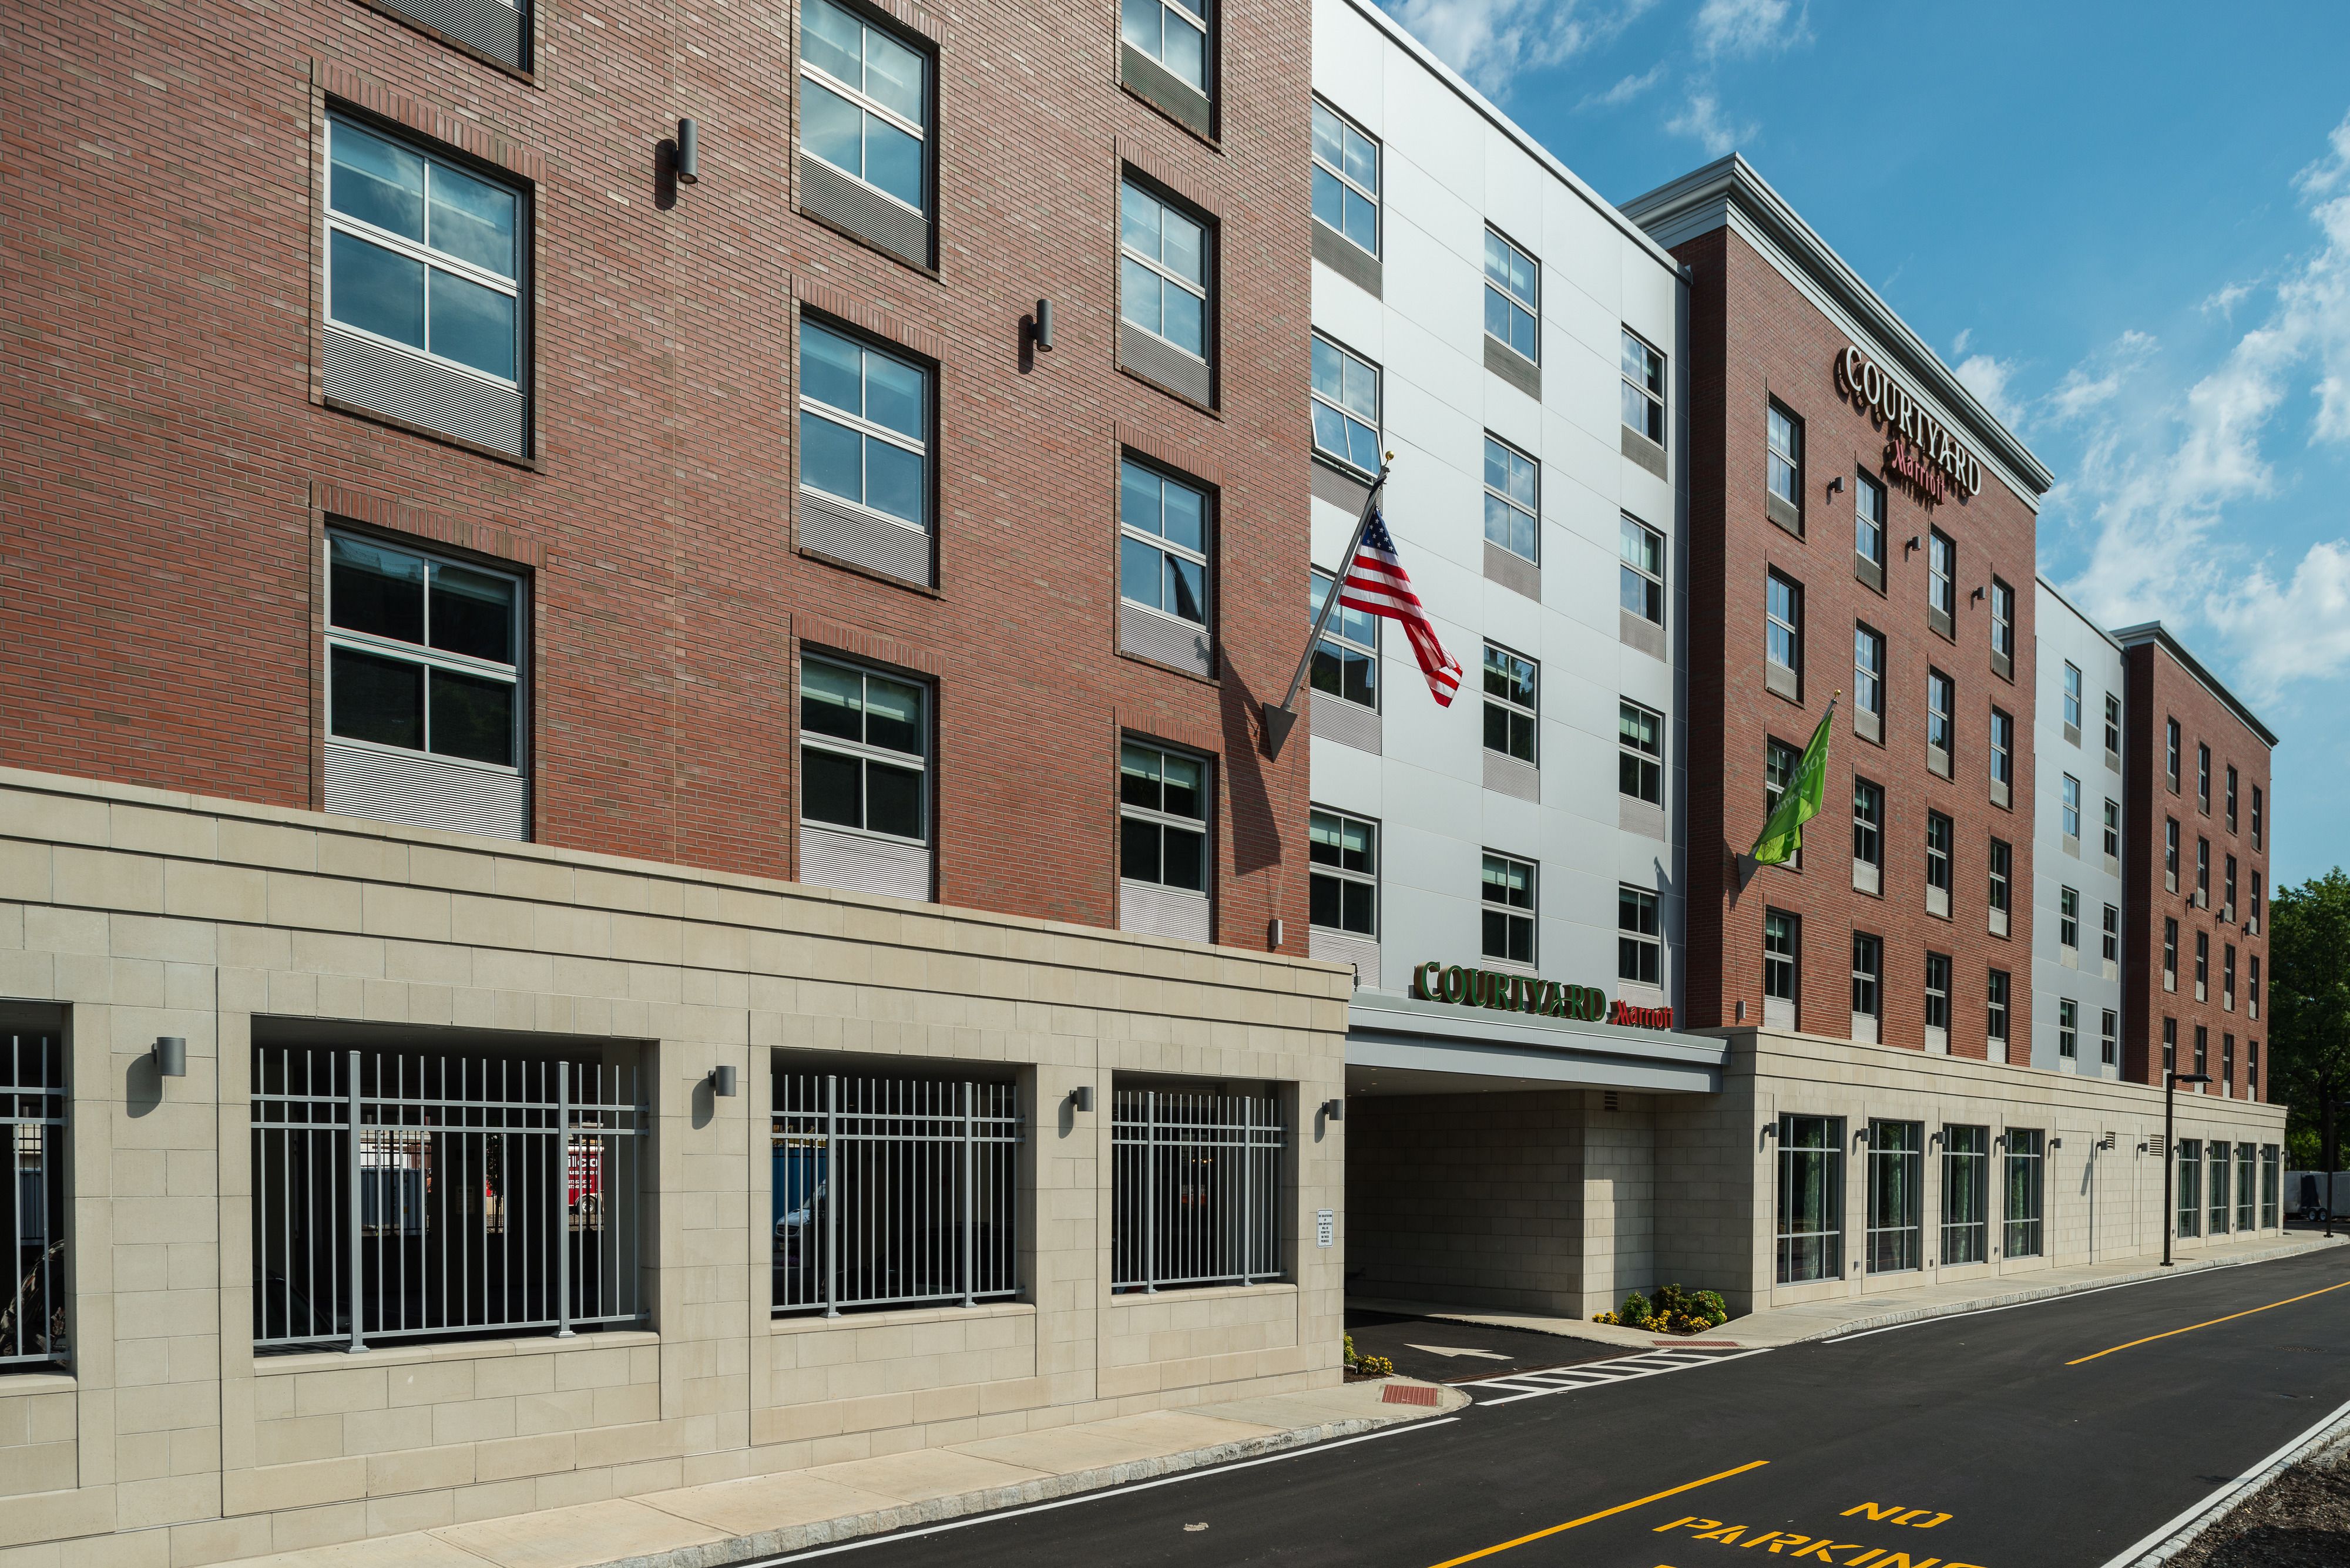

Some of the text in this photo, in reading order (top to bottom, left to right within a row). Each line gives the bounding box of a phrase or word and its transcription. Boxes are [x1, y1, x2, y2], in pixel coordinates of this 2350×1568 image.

[1845, 345, 1982, 496] COURTYARD
[1891, 439, 1945, 504] Marriott
[1416, 961, 1674, 1029] COURTYARD Marriott
[1651, 1516, 1989, 1568] PARKIN
[1839, 1502, 1953, 1528] NO
